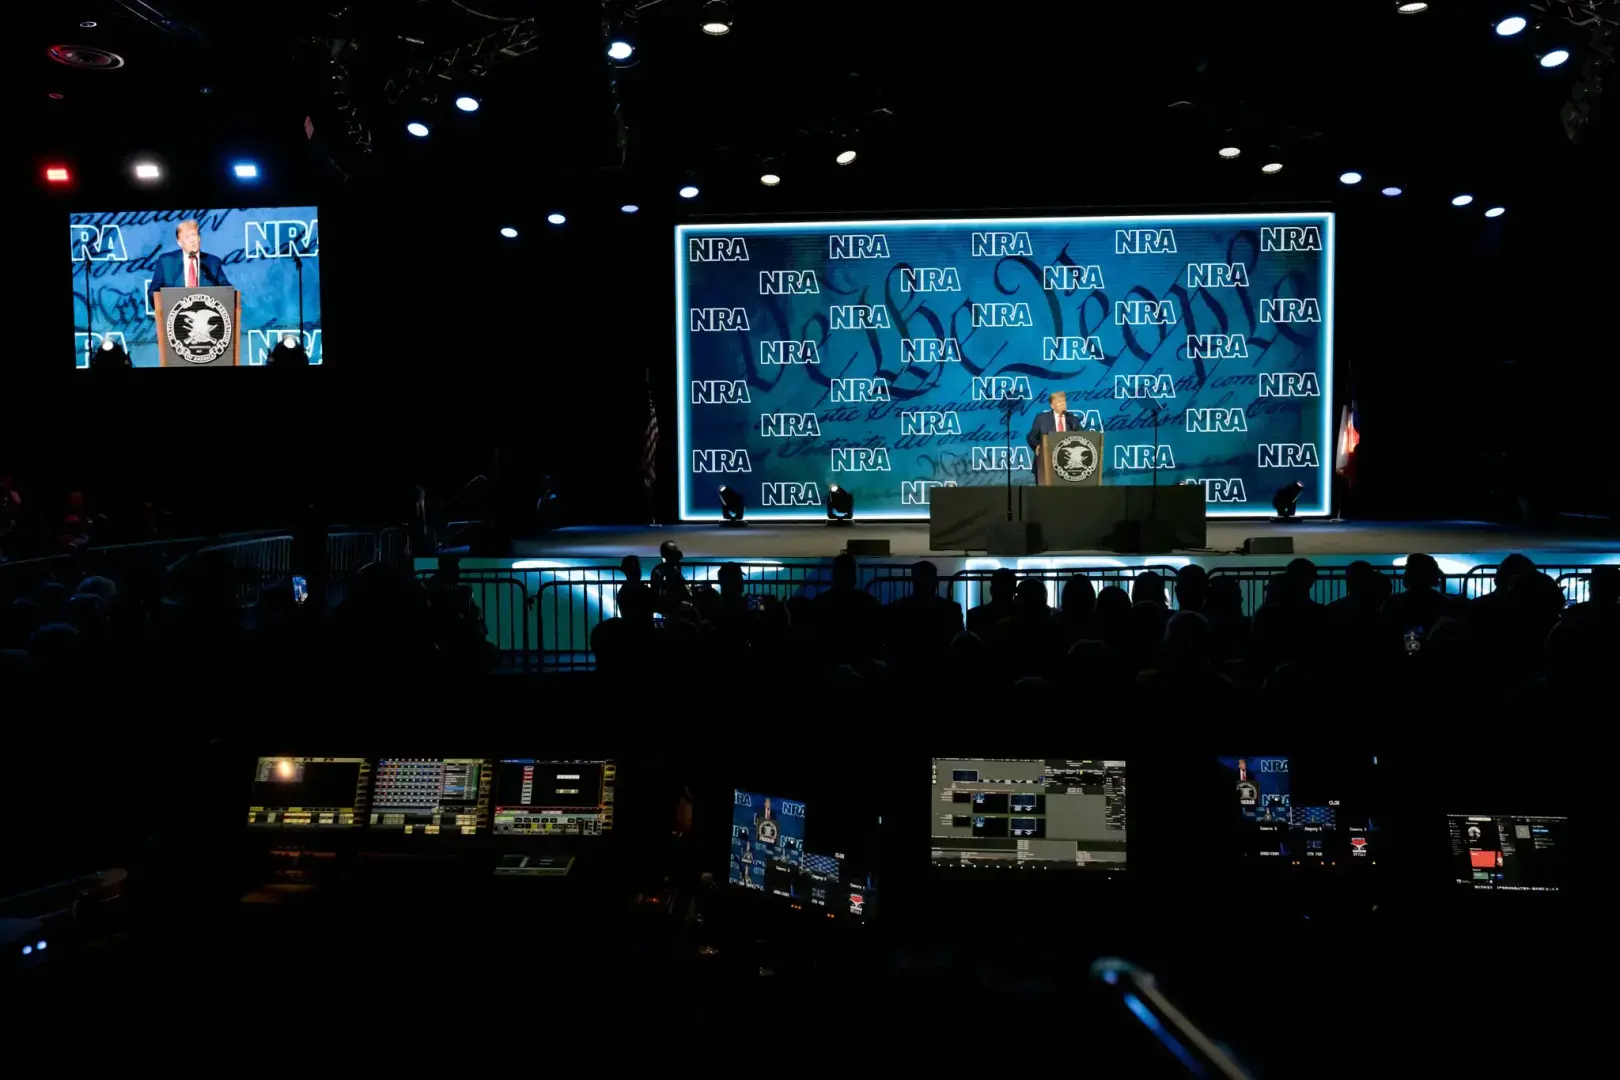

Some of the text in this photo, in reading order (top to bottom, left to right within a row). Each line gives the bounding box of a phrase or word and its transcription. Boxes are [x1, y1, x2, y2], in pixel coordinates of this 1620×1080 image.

[690, 238, 749, 261] NRA
[830, 235, 890, 259] NRA
[972, 232, 1032, 256] NRA
[1116, 229, 1177, 254] NRA
[1261, 227, 1322, 251] NRA
[760, 270, 819, 294] NRA
[901, 268, 961, 292] NRA
[1044, 266, 1104, 289] NRA
[1188, 263, 1249, 287] NRA
[691, 308, 750, 331] NRA
[830, 305, 890, 329] NRA
[972, 303, 1032, 327] NRA
[1116, 301, 1176, 325] NRA
[1260, 298, 1321, 322] NRA
[761, 341, 820, 364] NRA
[901, 338, 961, 362] NRA
[1044, 336, 1104, 360] NRA
[1187, 334, 1248, 358] NRA
[692, 380, 751, 403] NRA
[831, 378, 890, 402] NRA
[973, 376, 1032, 400] NRA
[1115, 375, 1176, 398] NRA
[1259, 373, 1320, 396] NRA
[762, 413, 820, 436] NRA
[902, 411, 961, 435] NRA
[1187, 408, 1247, 432] NRA
[693, 450, 751, 472] NRA
[832, 448, 891, 471] NRA
[972, 446, 1032, 470] NRA
[1115, 445, 1175, 468] NRA
[1258, 443, 1319, 467] NRA
[762, 482, 821, 505] NRA
